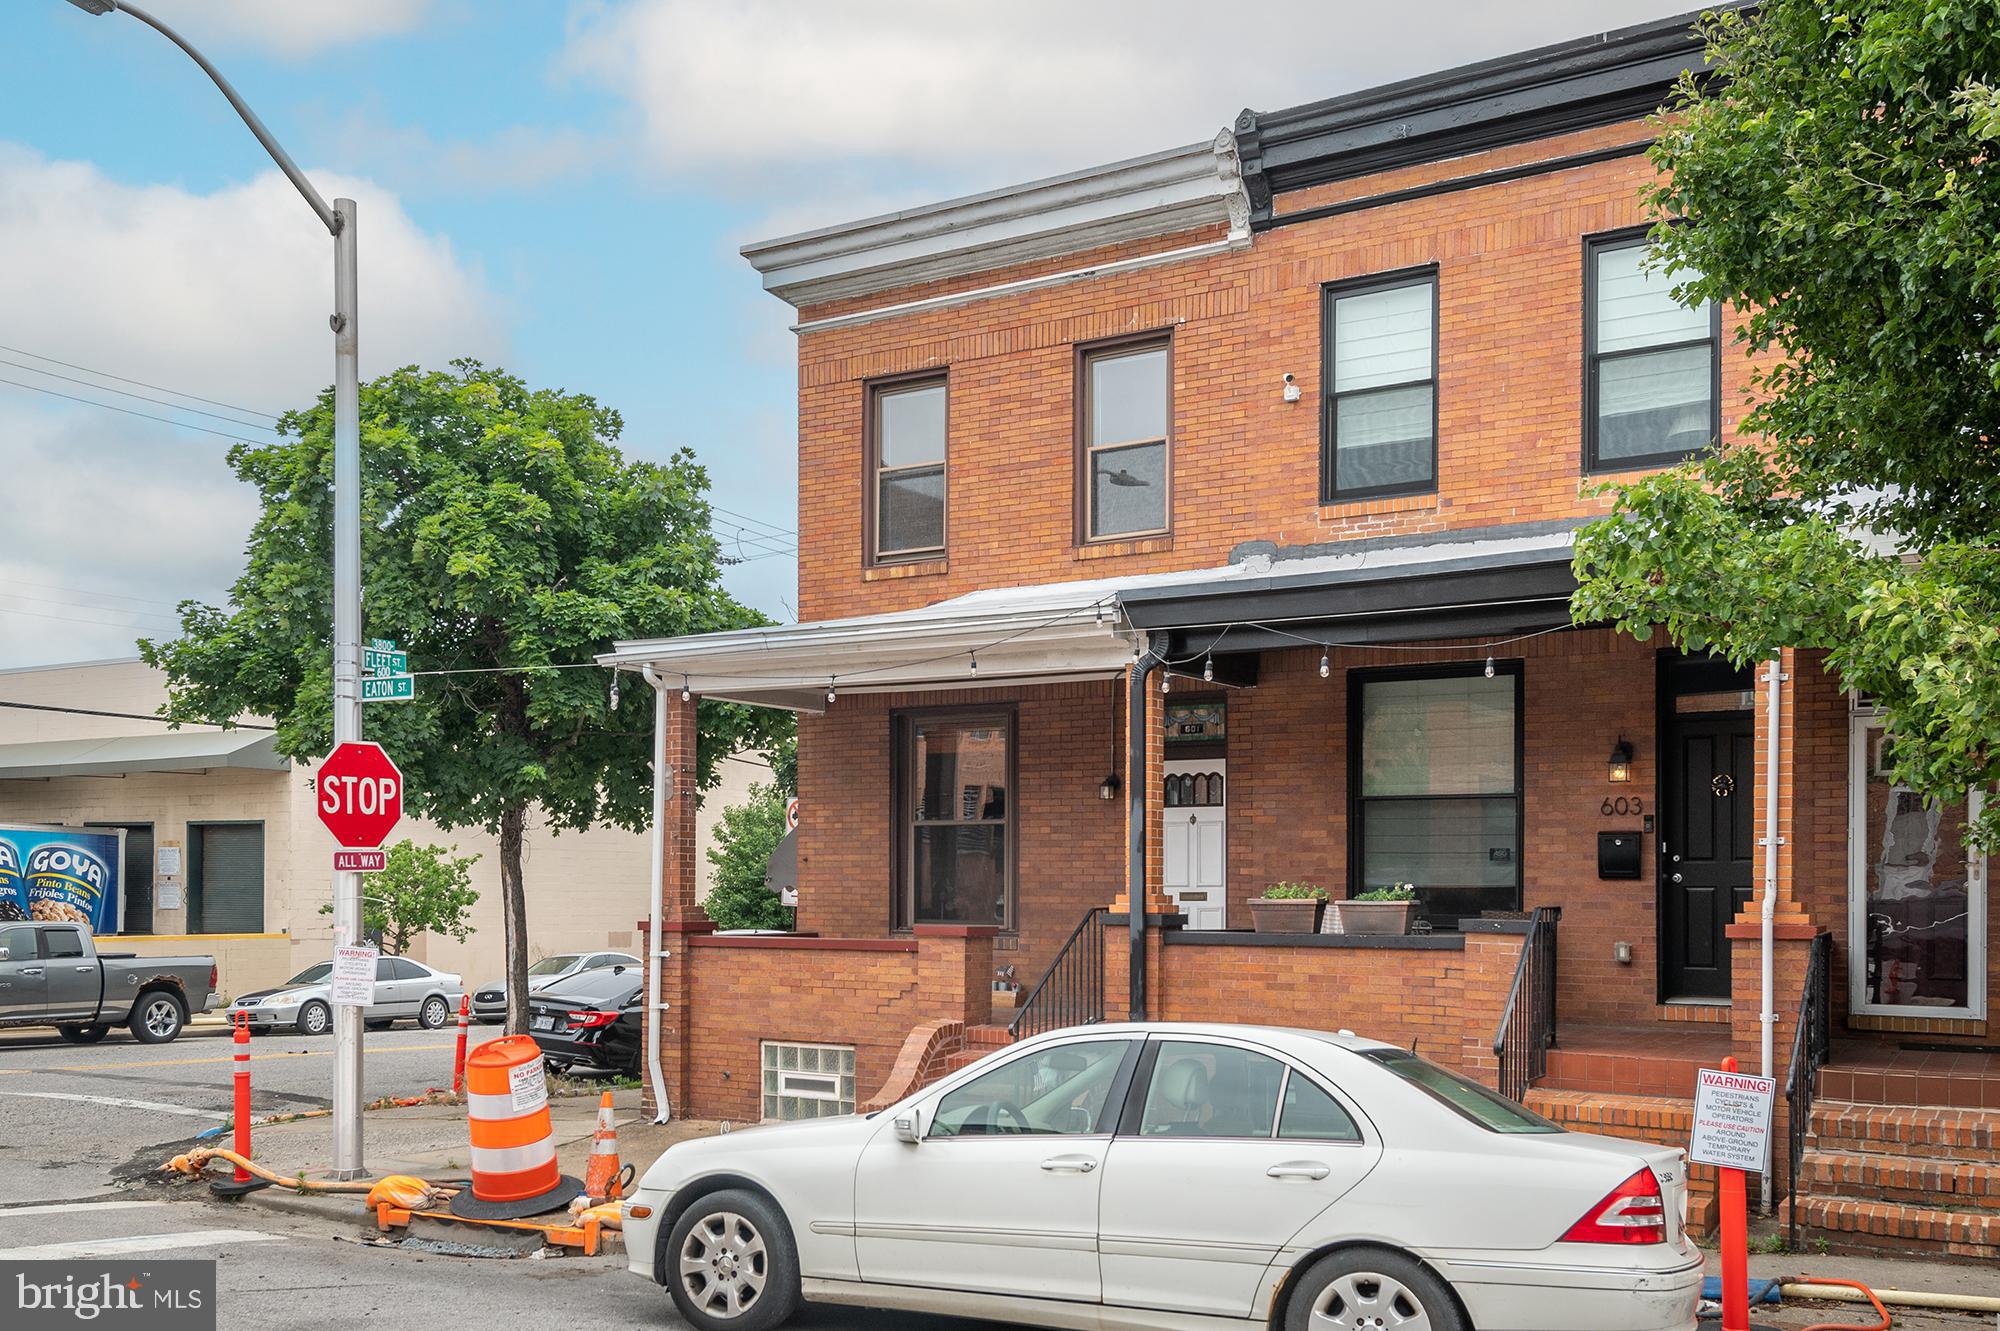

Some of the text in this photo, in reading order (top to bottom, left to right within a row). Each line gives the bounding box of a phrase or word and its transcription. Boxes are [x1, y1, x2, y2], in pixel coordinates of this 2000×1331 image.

[365, 651, 391, 668] FLEET
[377, 666, 390, 677] 600
[365, 680, 394, 697] EATON
[322, 775, 397, 816] STOP
[1600, 796, 1643, 816] 603
[338, 855, 381, 868] ALL WAY
[33, 850, 102, 888] GOYA
[0, 887, 17, 897] gros
[36, 878, 91, 900] Pinto Beans
[28, 888, 93, 912] Frijoles Pintos
[338, 949, 375, 958] WARNING!
[1703, 1073, 1771, 1092] WARNING!
[1711, 1090, 1760, 1102] PEDESTRIANS
[1715, 1098, 1748, 1108] CYCLISTS
[1705, 1104, 1762, 1118] MOTOR VEHICLE
[1711, 1112, 1754, 1124] OPERATORS
[1698, 1120, 1723, 1129] PLEASE
[1736, 1124, 1765, 1134] CAUTION
[1716, 1129, 1747, 1138] AROUND
[1702, 1134, 1759, 1147] ABOVE-GROUND
[1708, 1142, 1752, 1154] TEMPORARY
[1702, 1149, 1755, 1161] WATER SYSTEM
